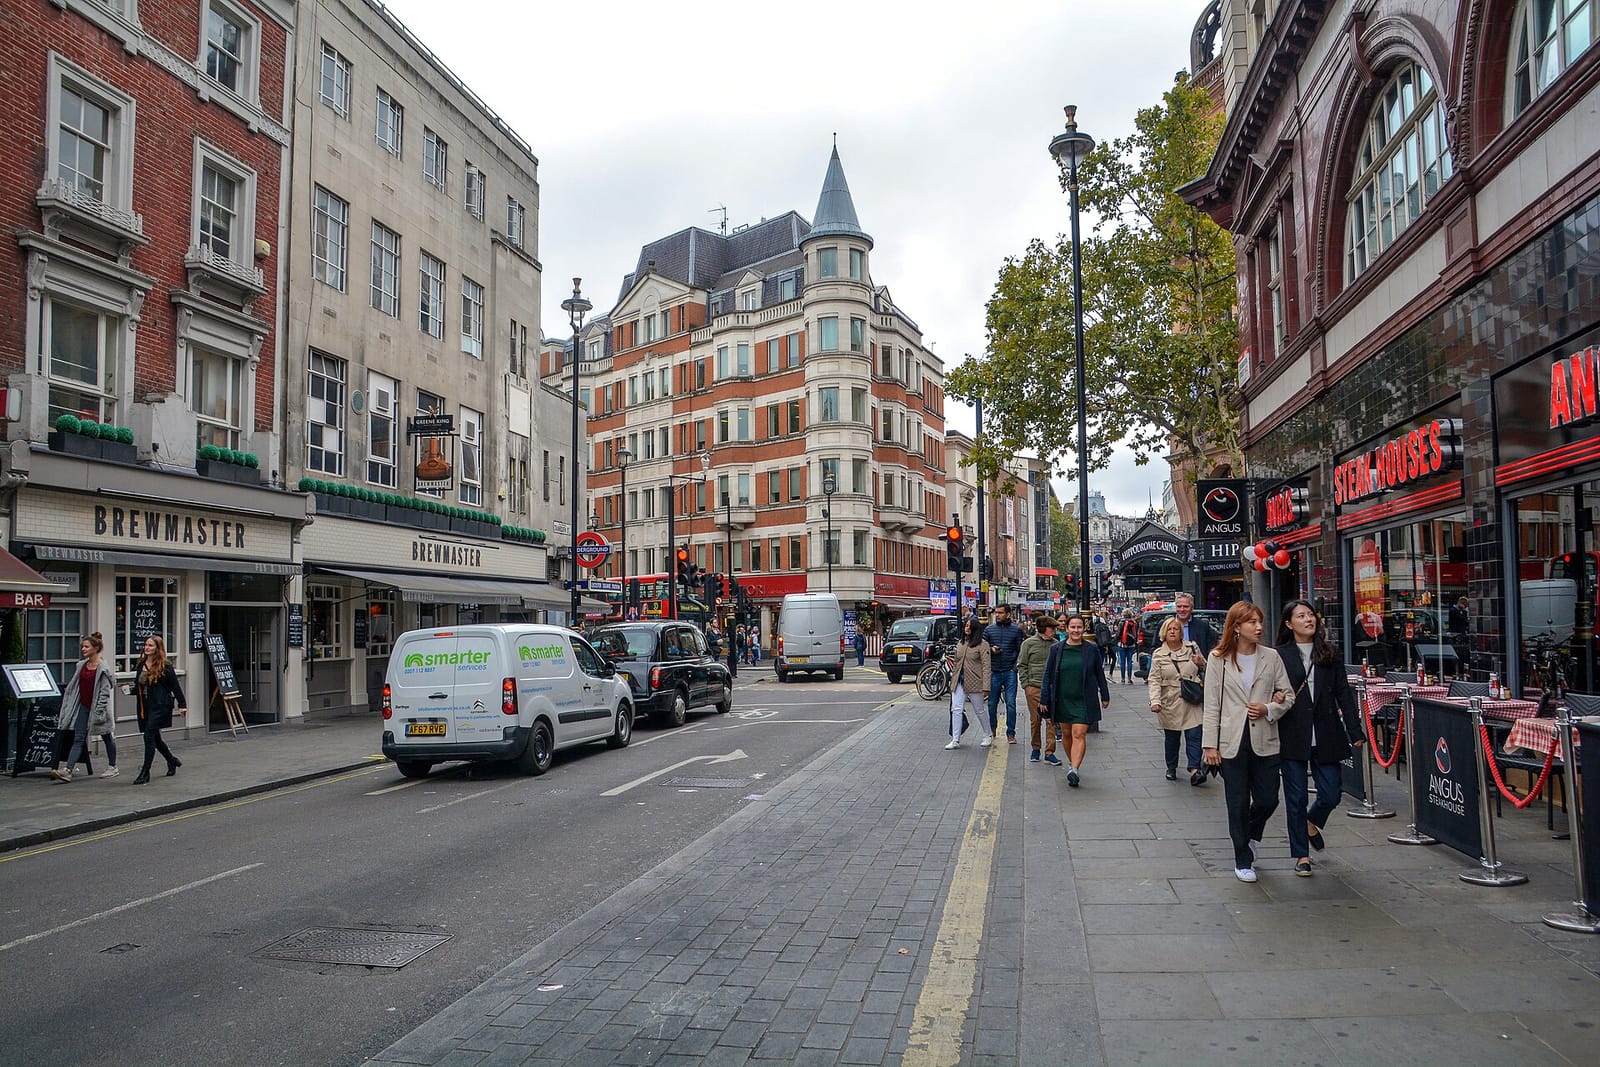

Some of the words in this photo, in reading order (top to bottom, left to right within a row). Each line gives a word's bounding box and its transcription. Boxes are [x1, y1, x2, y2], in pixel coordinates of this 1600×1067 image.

[1550, 345, 1600, 429] AN
[1334, 452, 1372, 506] STEAK
[1375, 419, 1442, 492] HOUSES
[95, 505, 246, 549] BREWMASTER
[1204, 523, 1242, 533] ANGUS
[41, 546, 104, 560] BREWMASTER
[412, 541, 482, 567] BREWMASTER
[1156, 541, 1178, 554] CASINO
[1211, 543, 1240, 557] HIP
[15, 593, 44, 606] BAR
[135, 609, 157, 618] CASK
[135, 618, 155, 629] ALE
[424, 649, 492, 666] smarter
[530, 644, 565, 660] smarter
[457, 664, 488, 672] services
[409, 725, 428, 735] AF67
[429, 724, 444, 734] RVE
[1429, 773, 1465, 804] ANGUS
[1428, 793, 1465, 817] STEAKHOUSE
